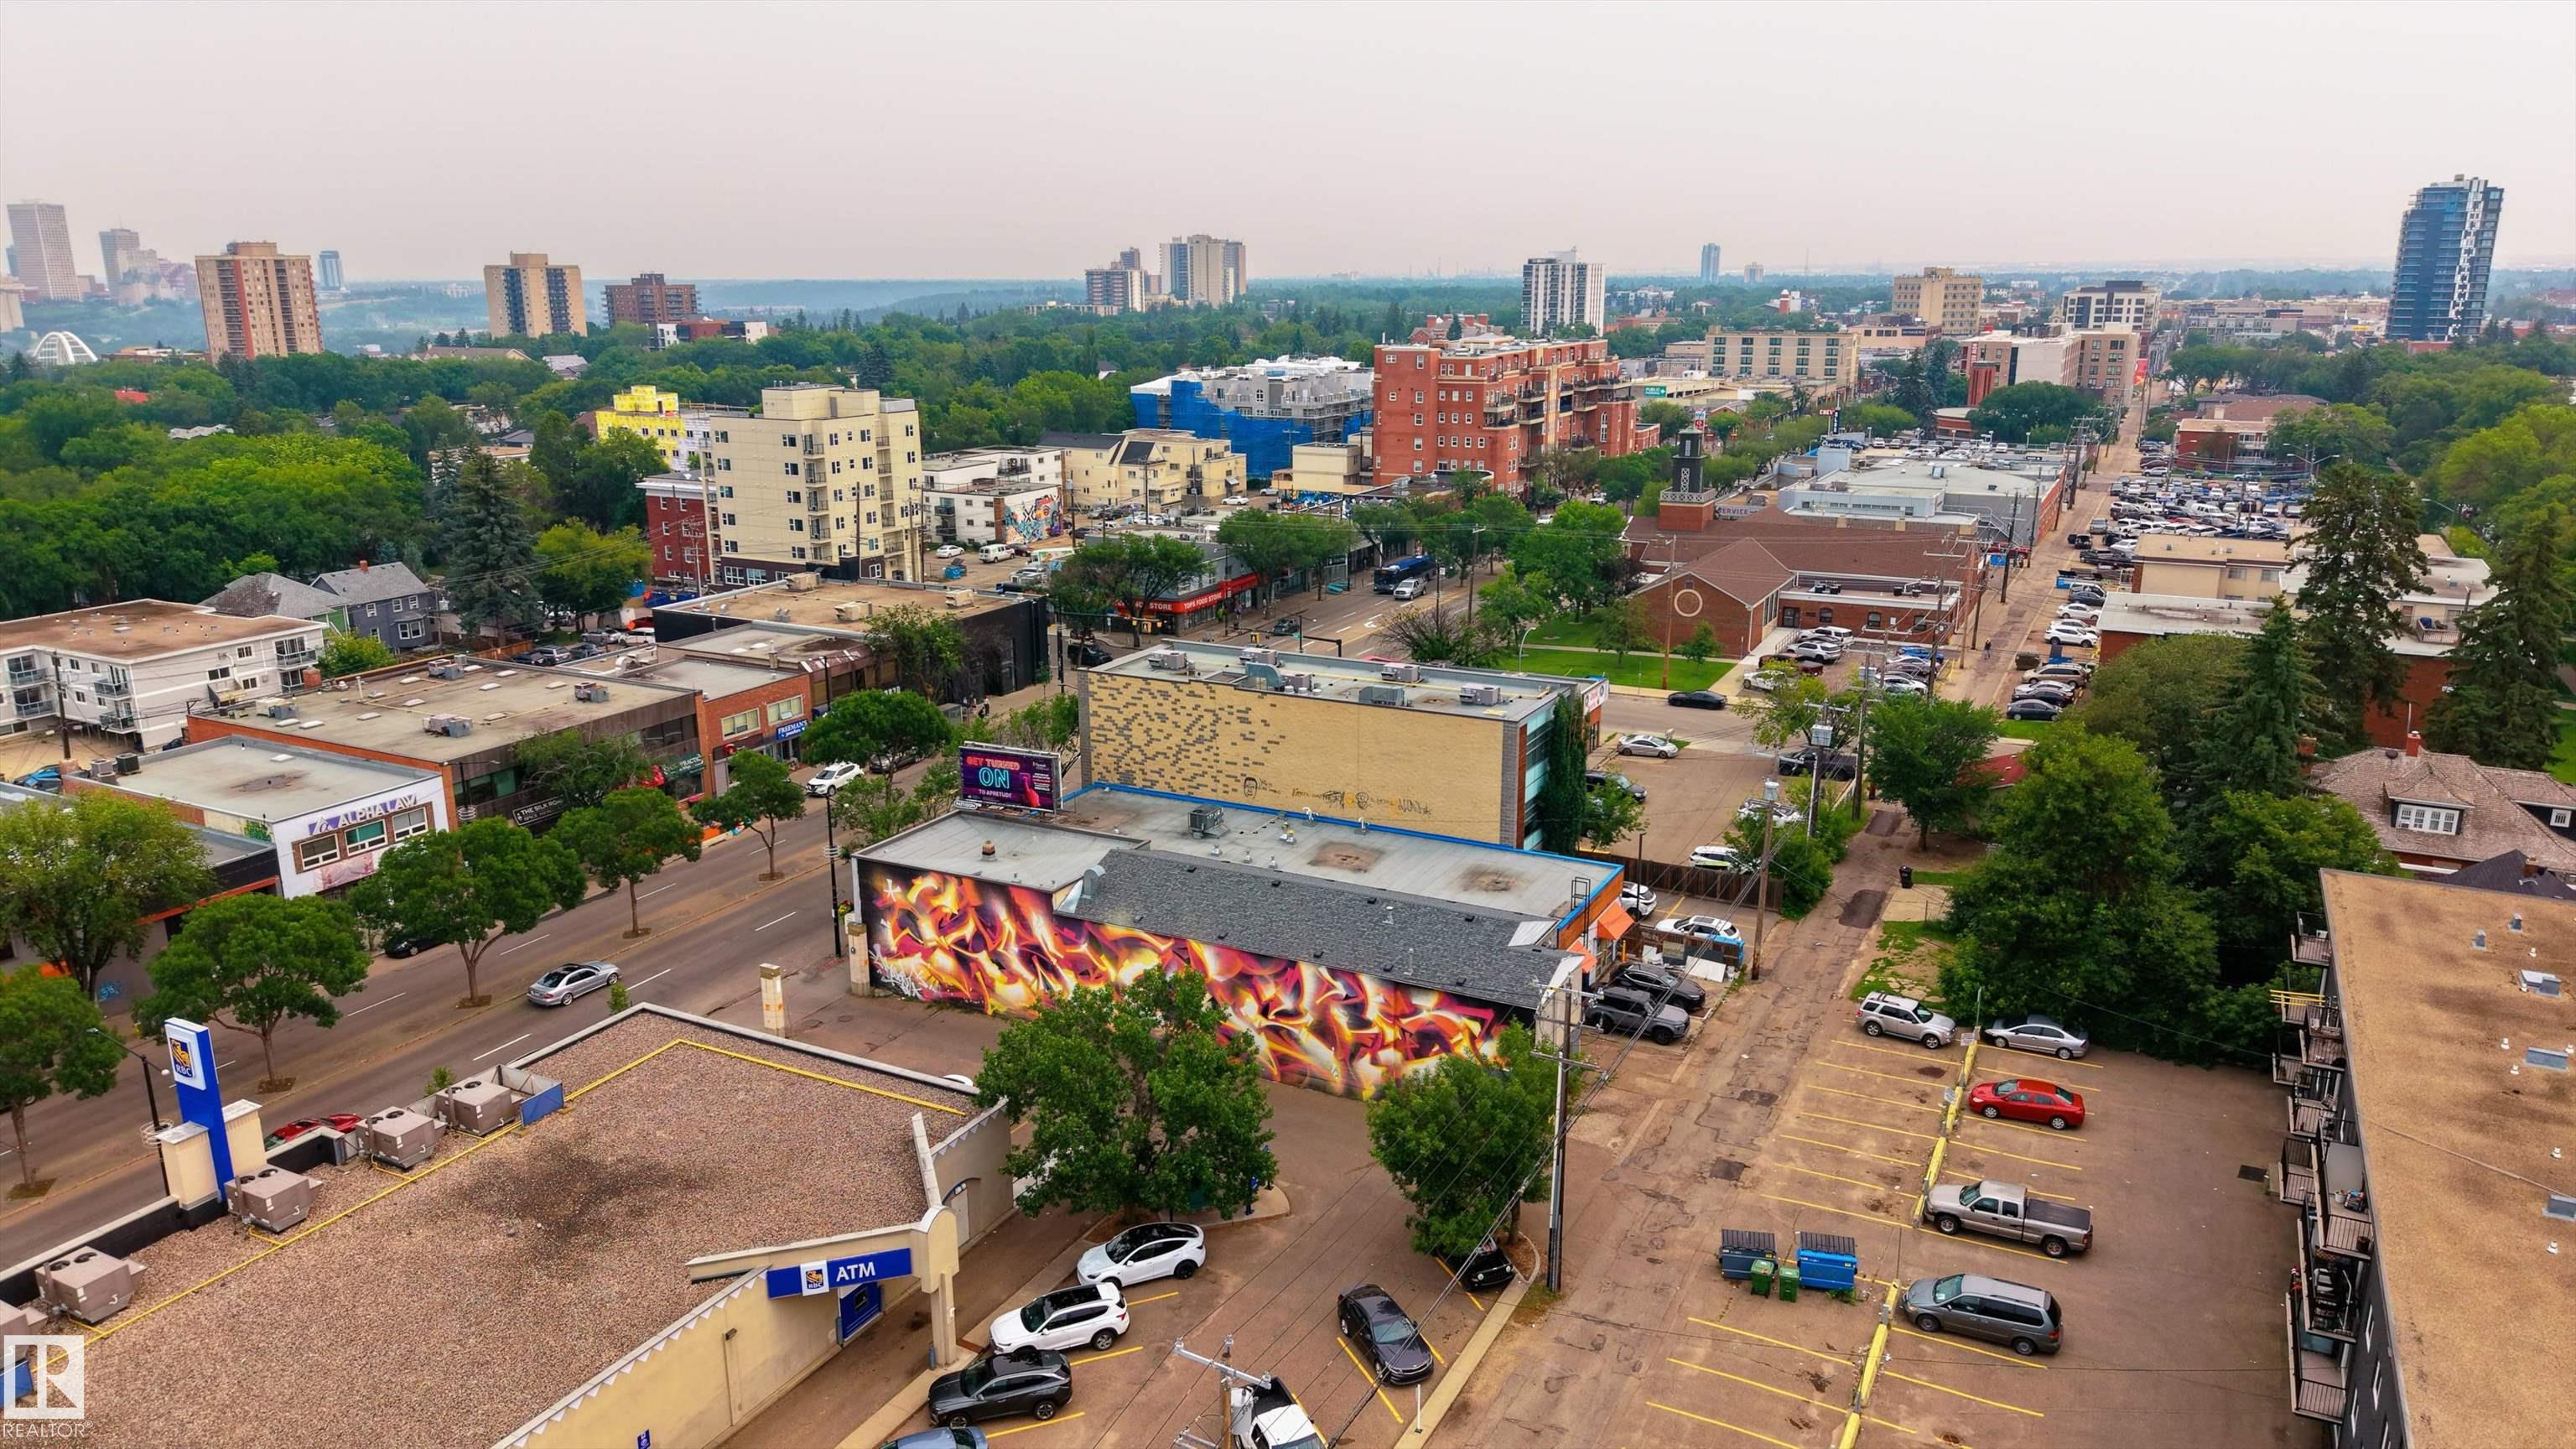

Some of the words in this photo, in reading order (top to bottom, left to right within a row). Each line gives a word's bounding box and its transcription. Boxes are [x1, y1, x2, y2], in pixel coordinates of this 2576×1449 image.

[1149, 602, 1172, 610] STORE
[1184, 600, 1196, 610] TOPS
[1197, 597, 1208, 605] FOOD
[1208, 592, 1222, 602] STORE
[966, 756, 984, 766] GET
[985, 758, 1021, 771] TURNED
[979, 766, 1010, 789] ON
[338, 803, 387, 828] ALPHA
[388, 792, 417, 812] LAW
[521, 807, 534, 815] THE
[533, 802, 548, 812] SILK
[175, 1063, 192, 1077] RBC
[836, 1261, 876, 1282] ATM
